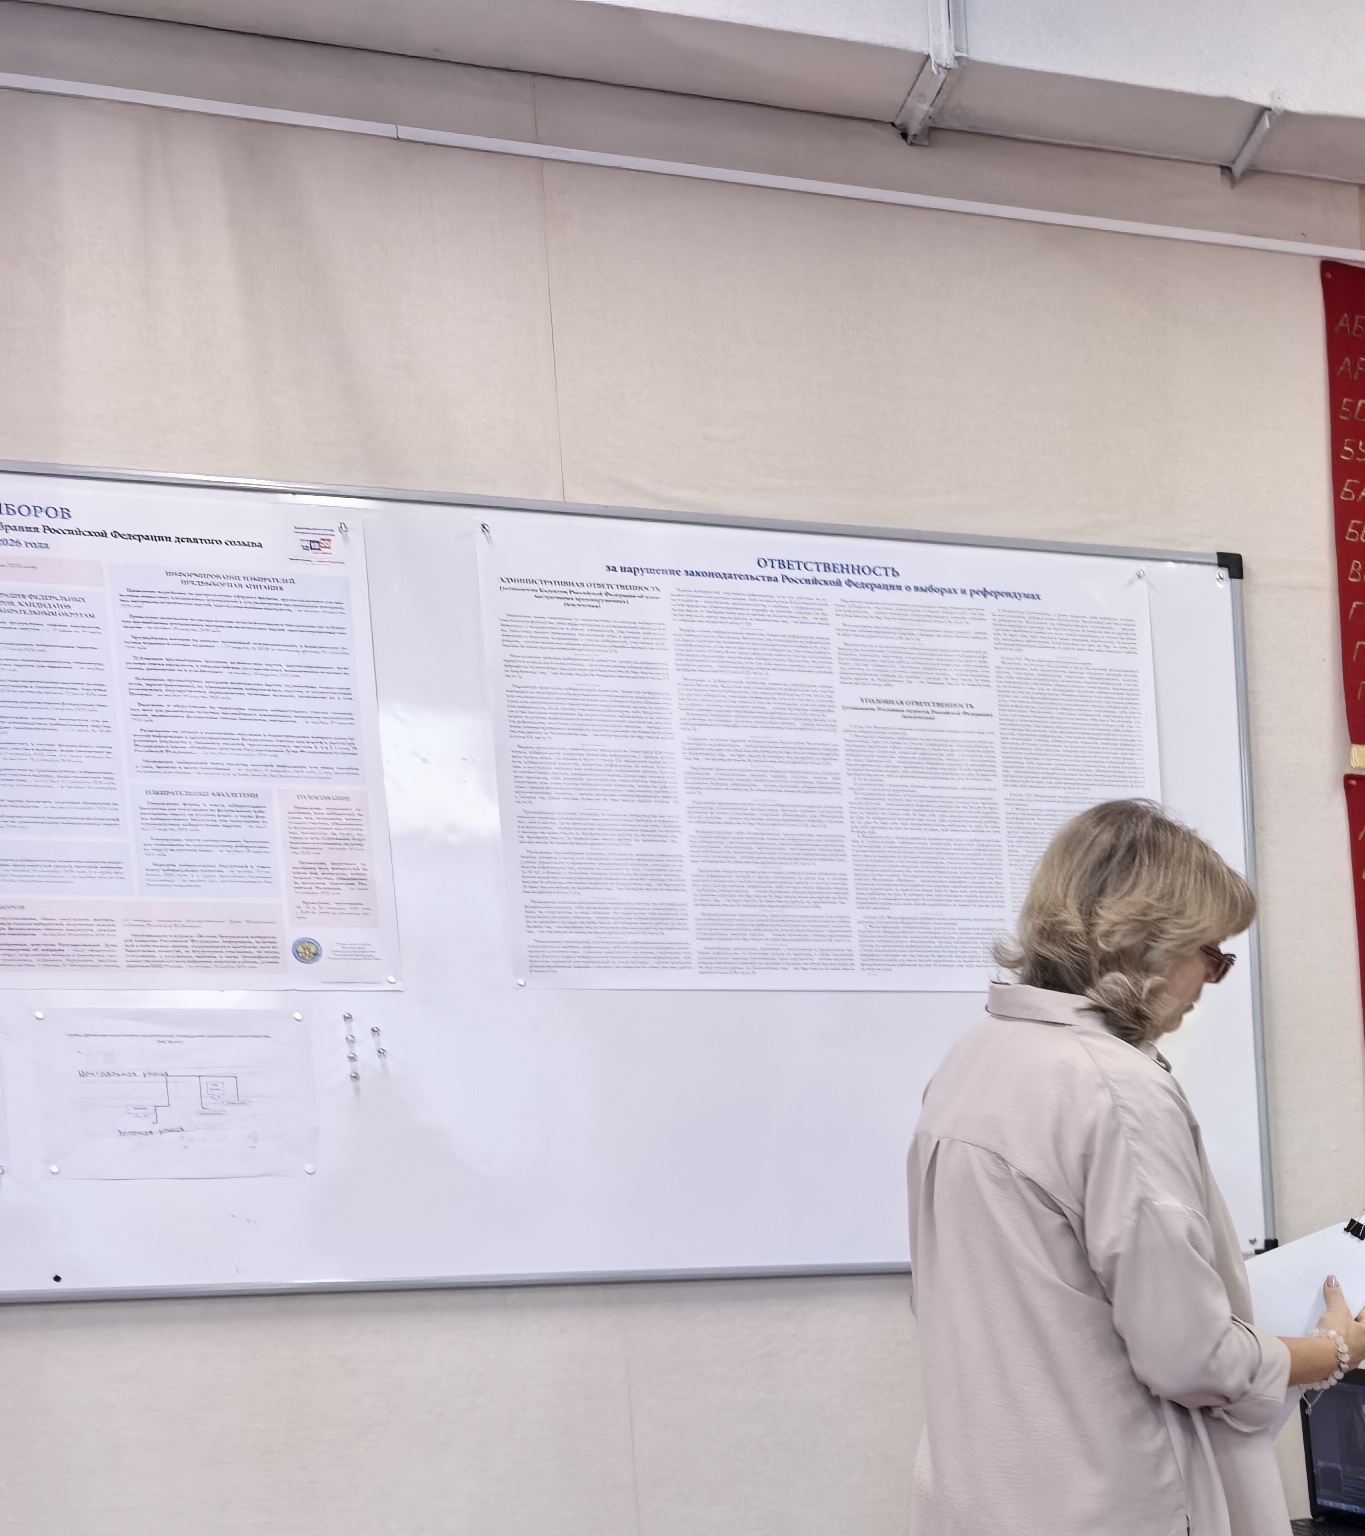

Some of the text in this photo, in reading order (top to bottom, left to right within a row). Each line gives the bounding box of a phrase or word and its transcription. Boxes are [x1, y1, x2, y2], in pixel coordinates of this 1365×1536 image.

[757, 556, 900, 578] ОТВЕТСТВЕННОСТЬ
[605, 564, 618, 574] за
[620, 565, 682, 578] нарушение
[684, 569, 779, 584] законодательства
[781, 573, 842, 588] Российской
[844, 578, 902, 593] Федерации
[914, 583, 958, 597] выборах
[969, 587, 1042, 601] референдумах
